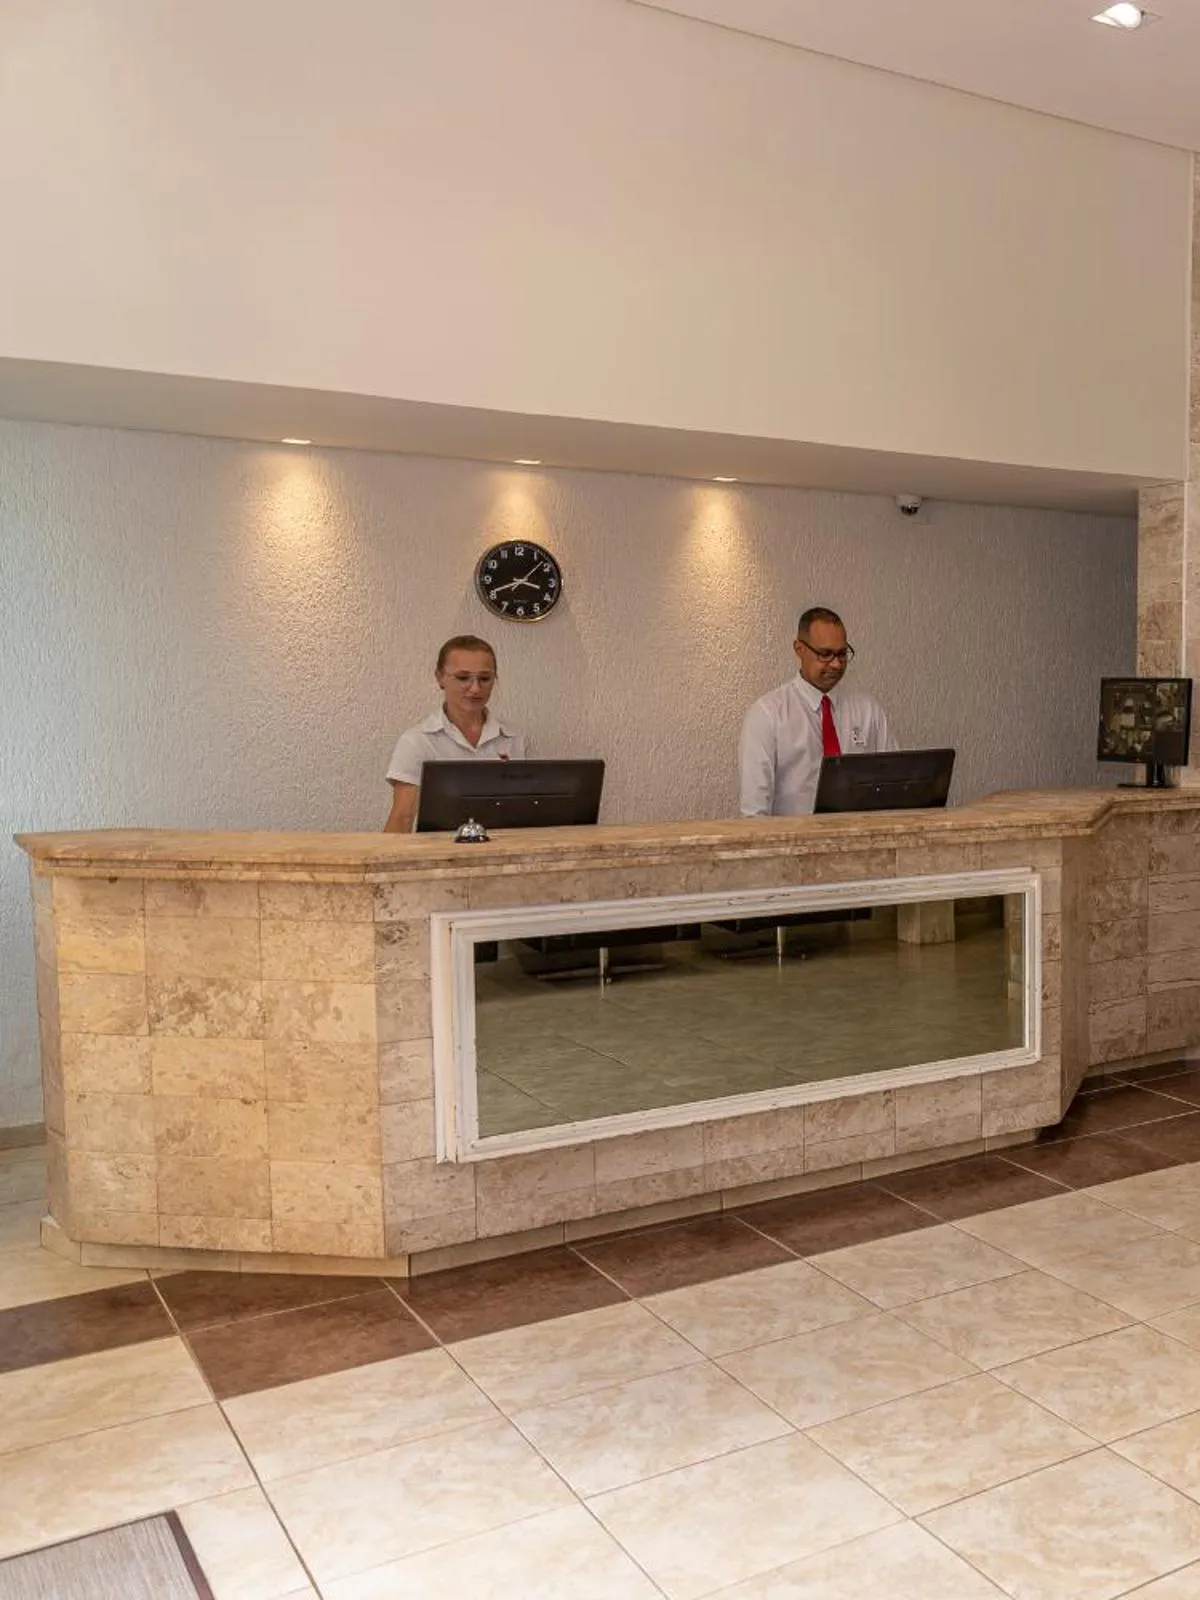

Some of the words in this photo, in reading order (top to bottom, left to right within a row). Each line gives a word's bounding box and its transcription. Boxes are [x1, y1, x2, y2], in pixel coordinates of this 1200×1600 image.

[514, 546, 524, 556] 12
[487, 560, 498, 569] 10
[543, 563, 552, 573] 2
[484, 575, 492, 585] 9
[548, 578, 556, 588] 3
[489, 590, 497, 600] 8
[543, 592, 551, 601] 4
[501, 601, 509, 613] 7
[516, 606, 525, 616] 6
[533, 602, 541, 612] 5
